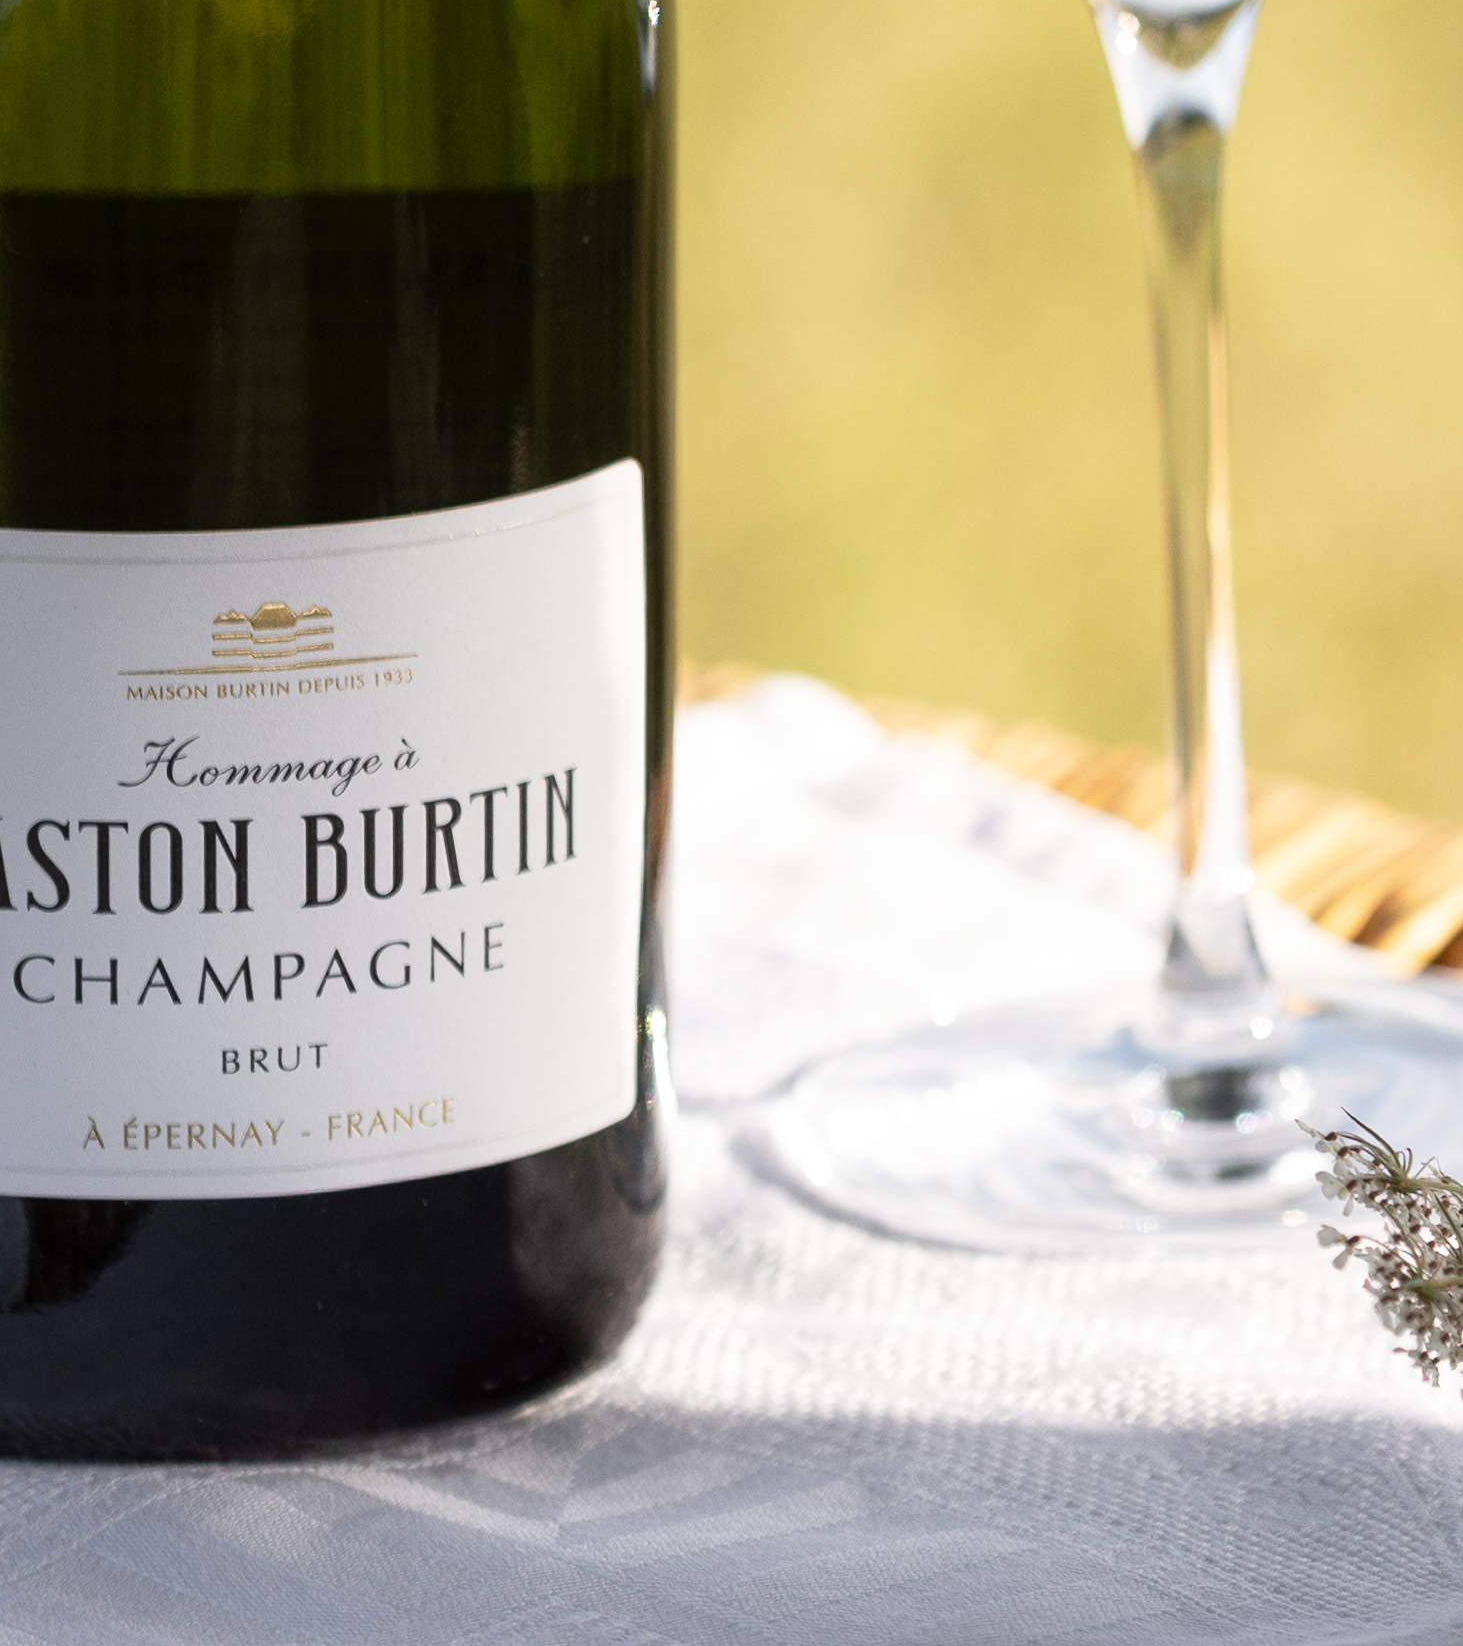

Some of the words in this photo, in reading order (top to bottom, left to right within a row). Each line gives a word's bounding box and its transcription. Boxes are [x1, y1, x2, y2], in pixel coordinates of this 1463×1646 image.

[127, 685, 207, 702] MAISON
[217, 680, 289, 700] BURTIN
[298, 673, 365, 695] DEPUIS
[373, 668, 414, 689] 1933
[116, 734, 383, 798] Hommage
[393, 737, 420, 771] à
[301, 765, 580, 909] BURTIN
[11, 922, 507, 1006] CHAMPAGNE
[221, 1042, 328, 1075] BRUT
[82, 1116, 106, 1150] À
[122, 1116, 284, 1151] ÉPERNAY
[326, 1097, 455, 1142] FRANCE
